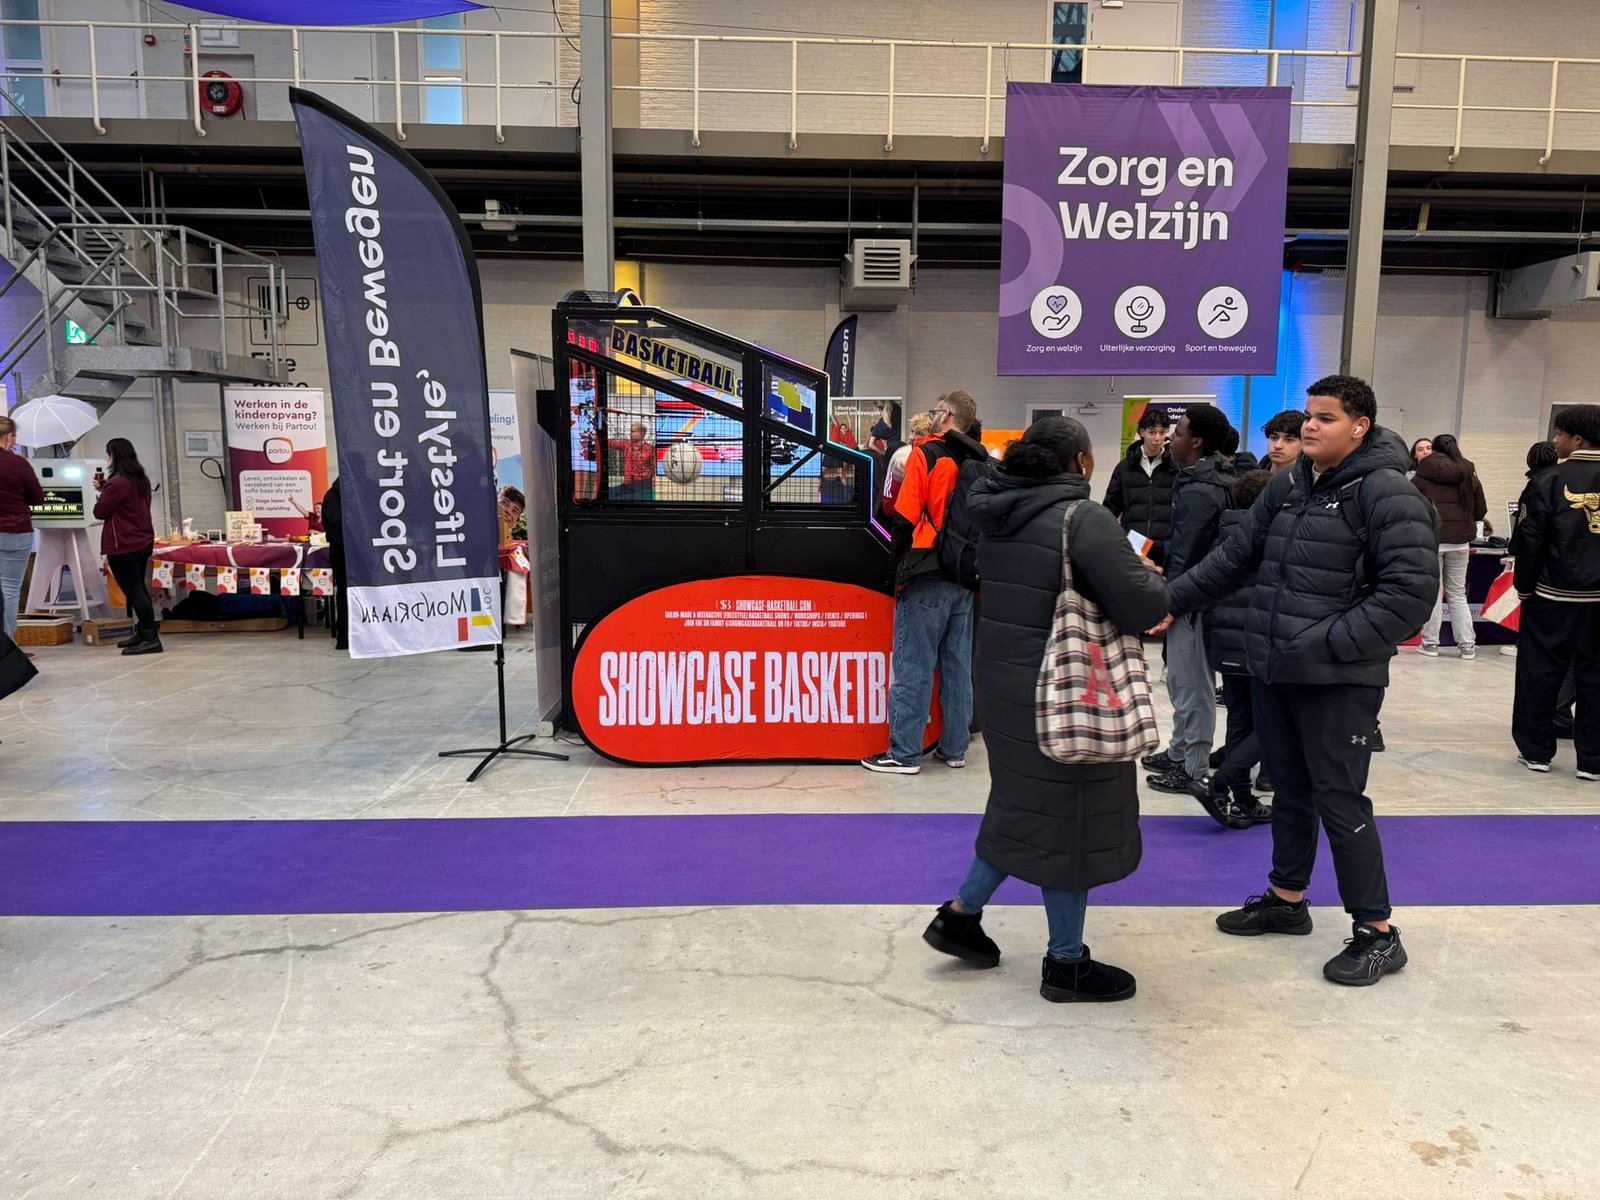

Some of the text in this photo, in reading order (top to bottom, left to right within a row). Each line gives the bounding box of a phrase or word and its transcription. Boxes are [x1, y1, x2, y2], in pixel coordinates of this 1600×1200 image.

[1057, 146, 1234, 196] Zorg en
[1058, 200, 1229, 250] Welzijn
[1026, 344, 1044, 353] Zorg
[1056, 344, 1083, 353] welzijn
[1100, 344, 1176, 353] Uiterlijke verzorging
[1185, 344, 1207, 353] Sport
[1219, 344, 1257, 353] beweging
[610, 324, 735, 397] BASKETBALL
[234, 399, 308, 409] Werken in de
[234, 409, 317, 421] kinderopvang?
[235, 422, 317, 431] Werken bij Partou!
[268, 448, 290, 456] partou
[598, 650, 931, 727] SHOWCASE BASKETB
